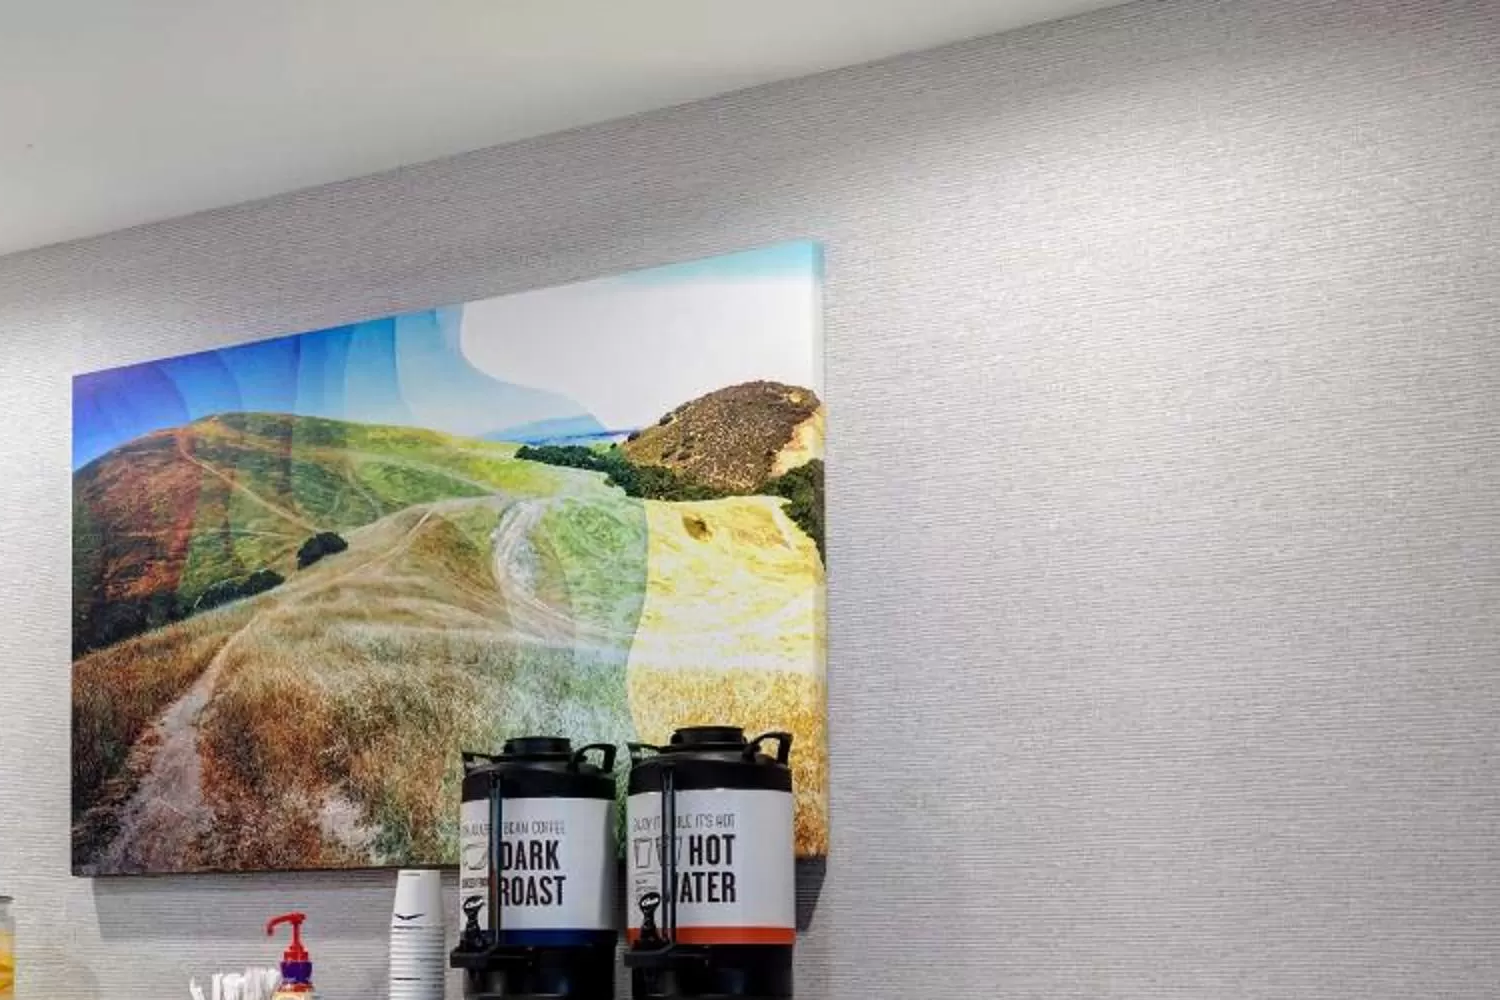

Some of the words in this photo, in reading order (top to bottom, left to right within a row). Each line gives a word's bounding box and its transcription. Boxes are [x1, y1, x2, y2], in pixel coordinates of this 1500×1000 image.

[499, 839, 561, 871] DARK
[688, 833, 737, 867] HOT
[499, 875, 567, 907] ROAST
[674, 871, 737, 903] ATER
